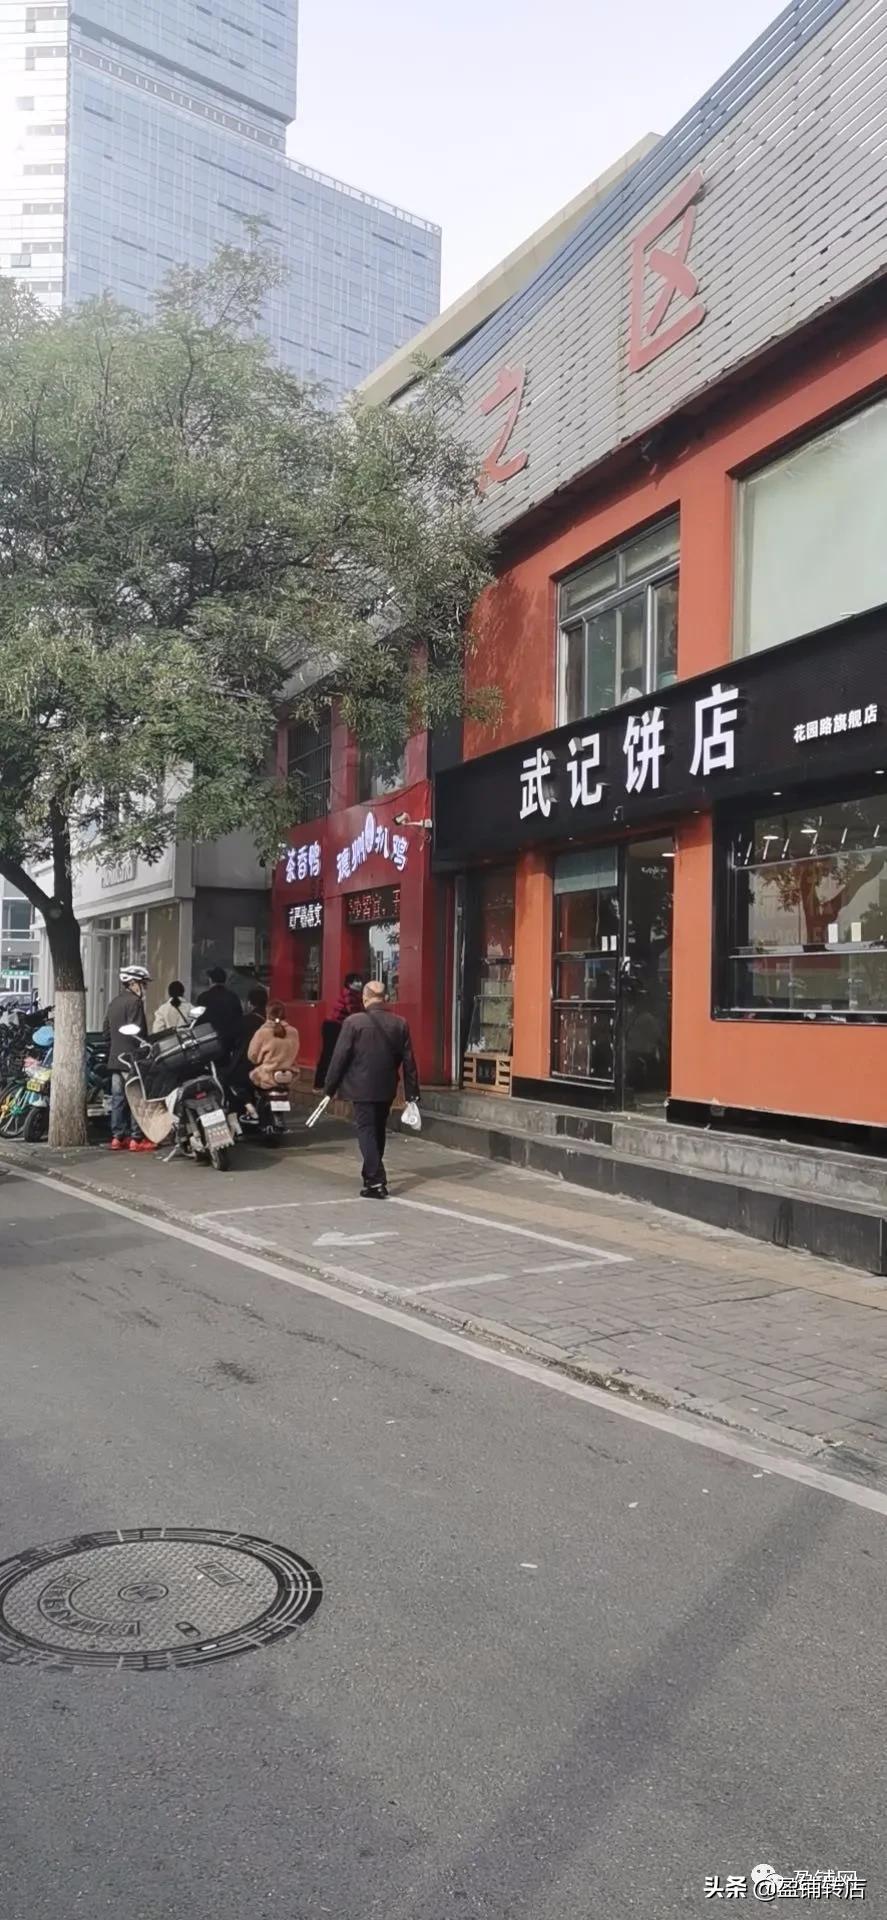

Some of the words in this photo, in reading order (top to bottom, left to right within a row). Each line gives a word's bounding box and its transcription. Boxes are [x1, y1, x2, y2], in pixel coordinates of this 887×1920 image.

[793, 705, 878, 742] 花园路旗舰店
[519, 683, 741, 819] 武记饼店
[286, 840, 321, 883] 茶香鸭
